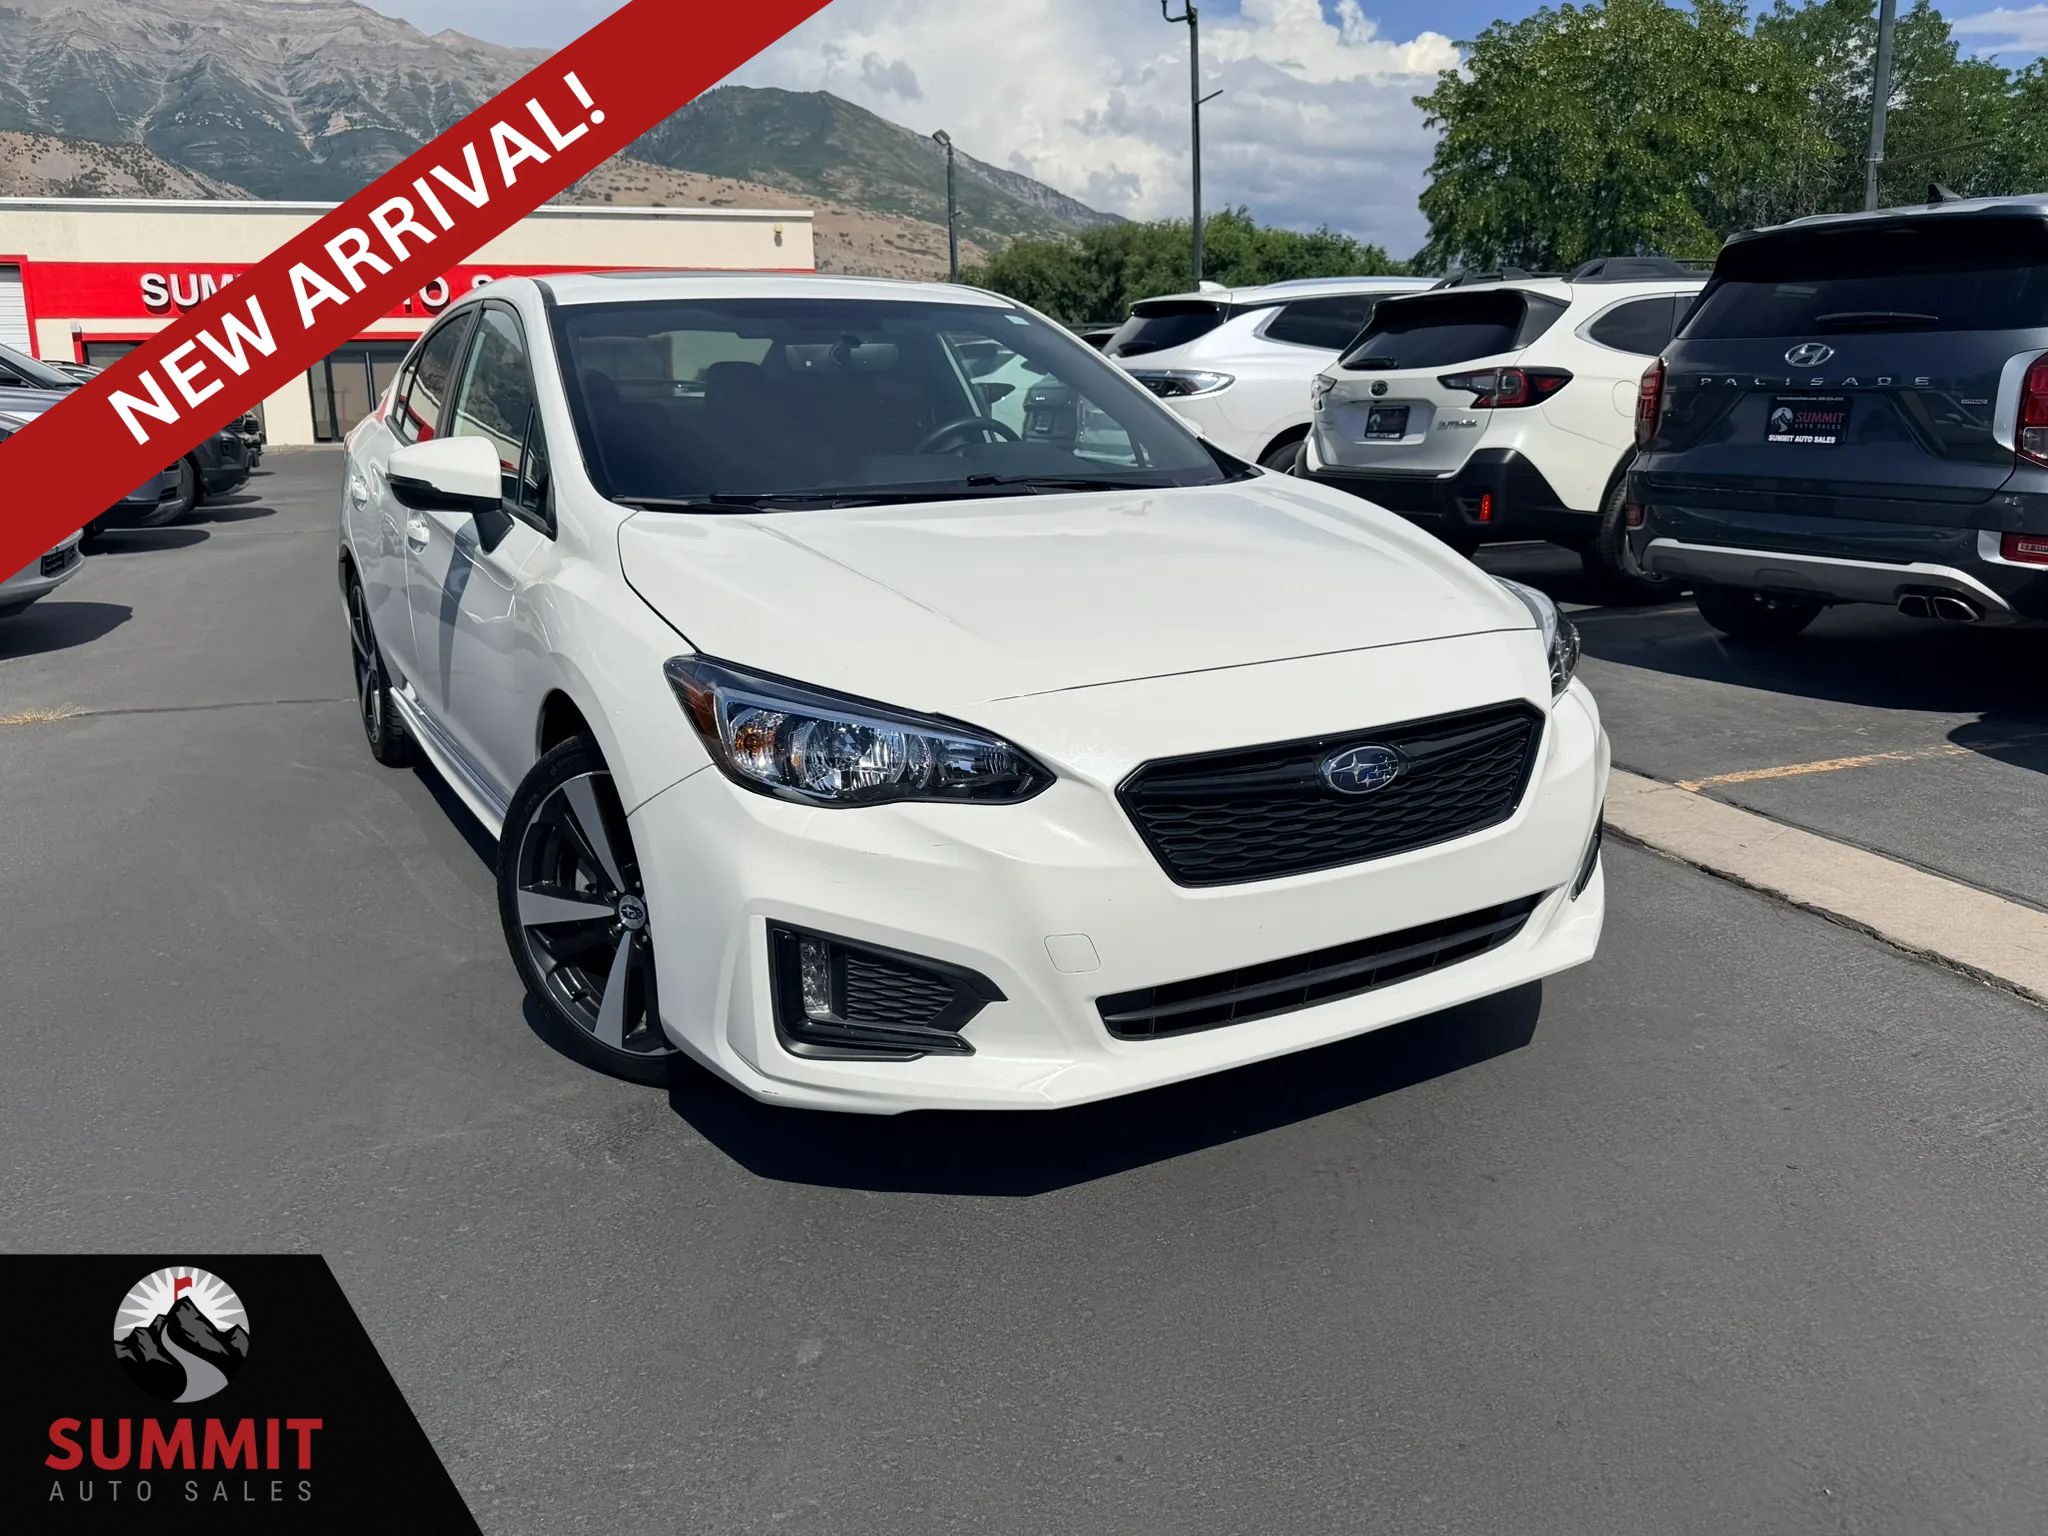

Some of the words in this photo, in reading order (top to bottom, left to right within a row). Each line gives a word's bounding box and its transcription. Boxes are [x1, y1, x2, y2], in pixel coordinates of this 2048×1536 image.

[1700, 376, 1930, 386] PALISADE
[1795, 411, 1845, 424] SUMMIT
[1768, 434, 1794, 442] SUMMIT
[1794, 435, 1813, 443] AUTO
[1813, 436, 1836, 444] SALES
